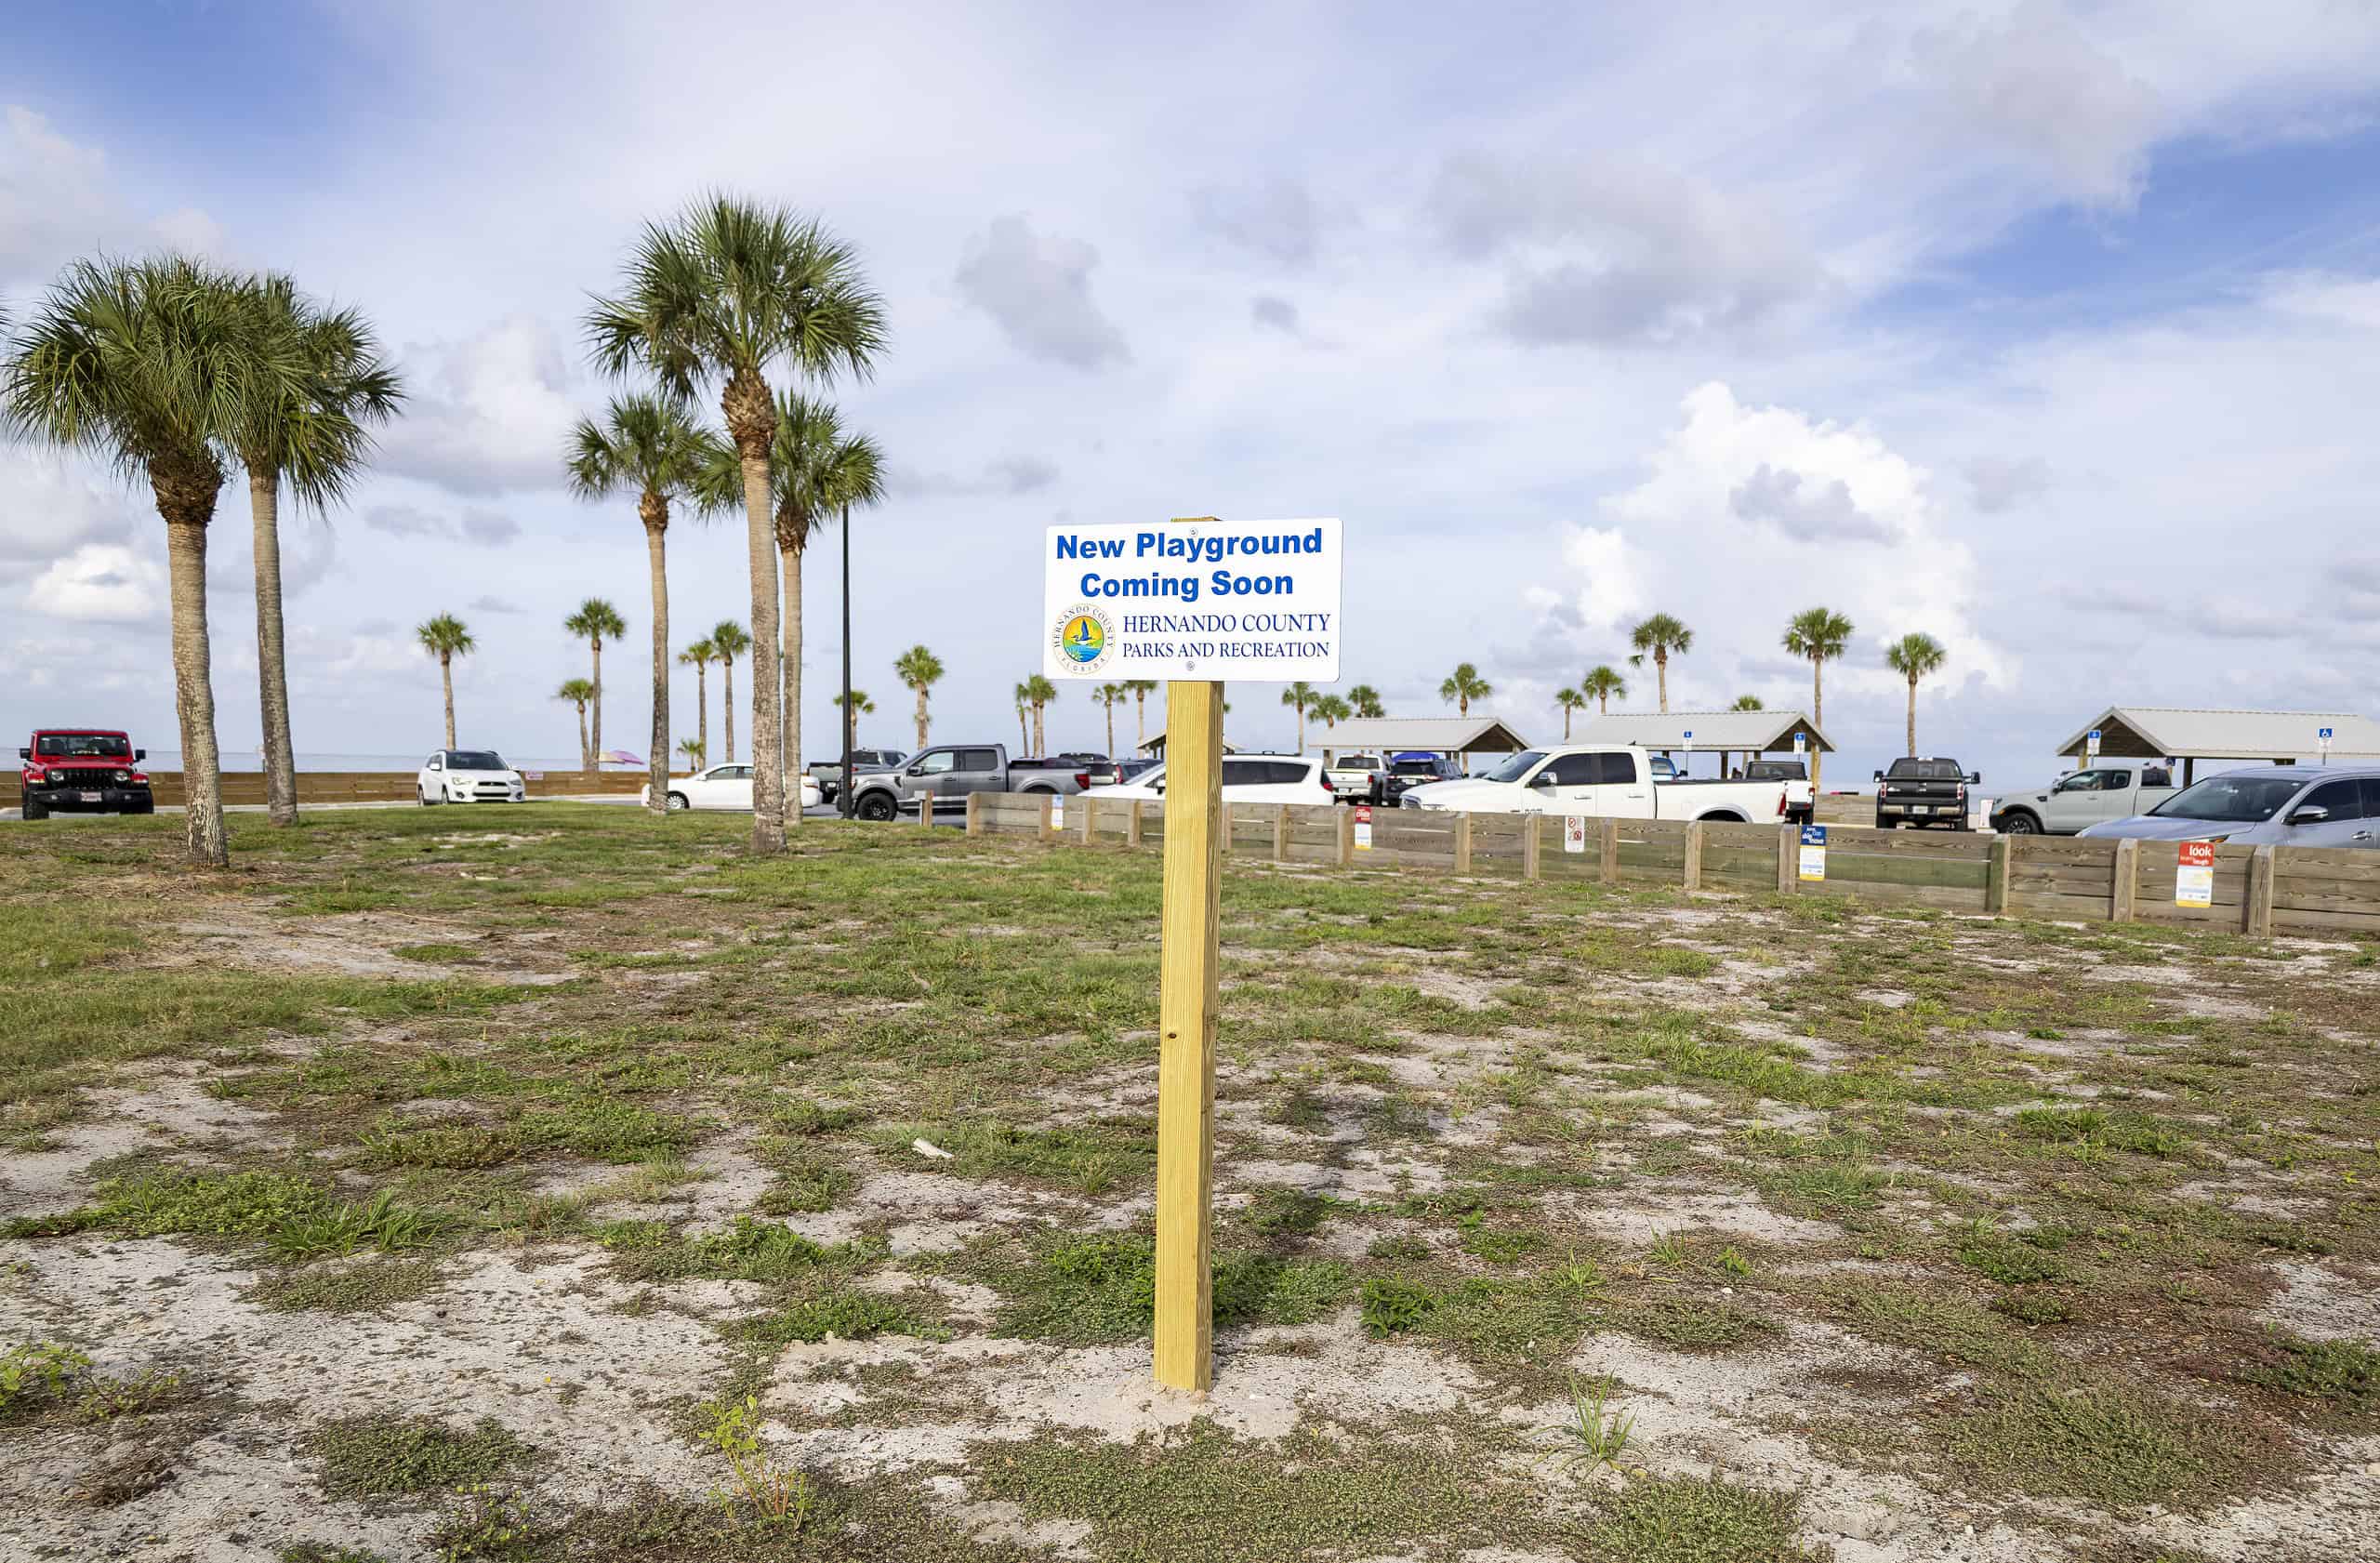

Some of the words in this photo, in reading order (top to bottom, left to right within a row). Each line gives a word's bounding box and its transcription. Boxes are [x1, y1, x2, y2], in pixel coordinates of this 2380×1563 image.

[1057, 535, 1125, 560] New
[1137, 528, 1322, 563] Playground
[1080, 573, 1199, 603] Coming
[1211, 571, 1293, 595] Soon
[1054, 605, 1090, 648] HERNANDO
[1092, 608, 1114, 648] COUNTY
[1123, 615, 1236, 633] HERNANDO
[1242, 614, 1330, 632] COUNTY
[1123, 642, 1174, 657] PARKS
[1178, 642, 1214, 657] AND
[1220, 642, 1329, 657] RECREATION
[1061, 656, 1105, 672] FLORIDA
[2189, 845, 2211, 856] look
